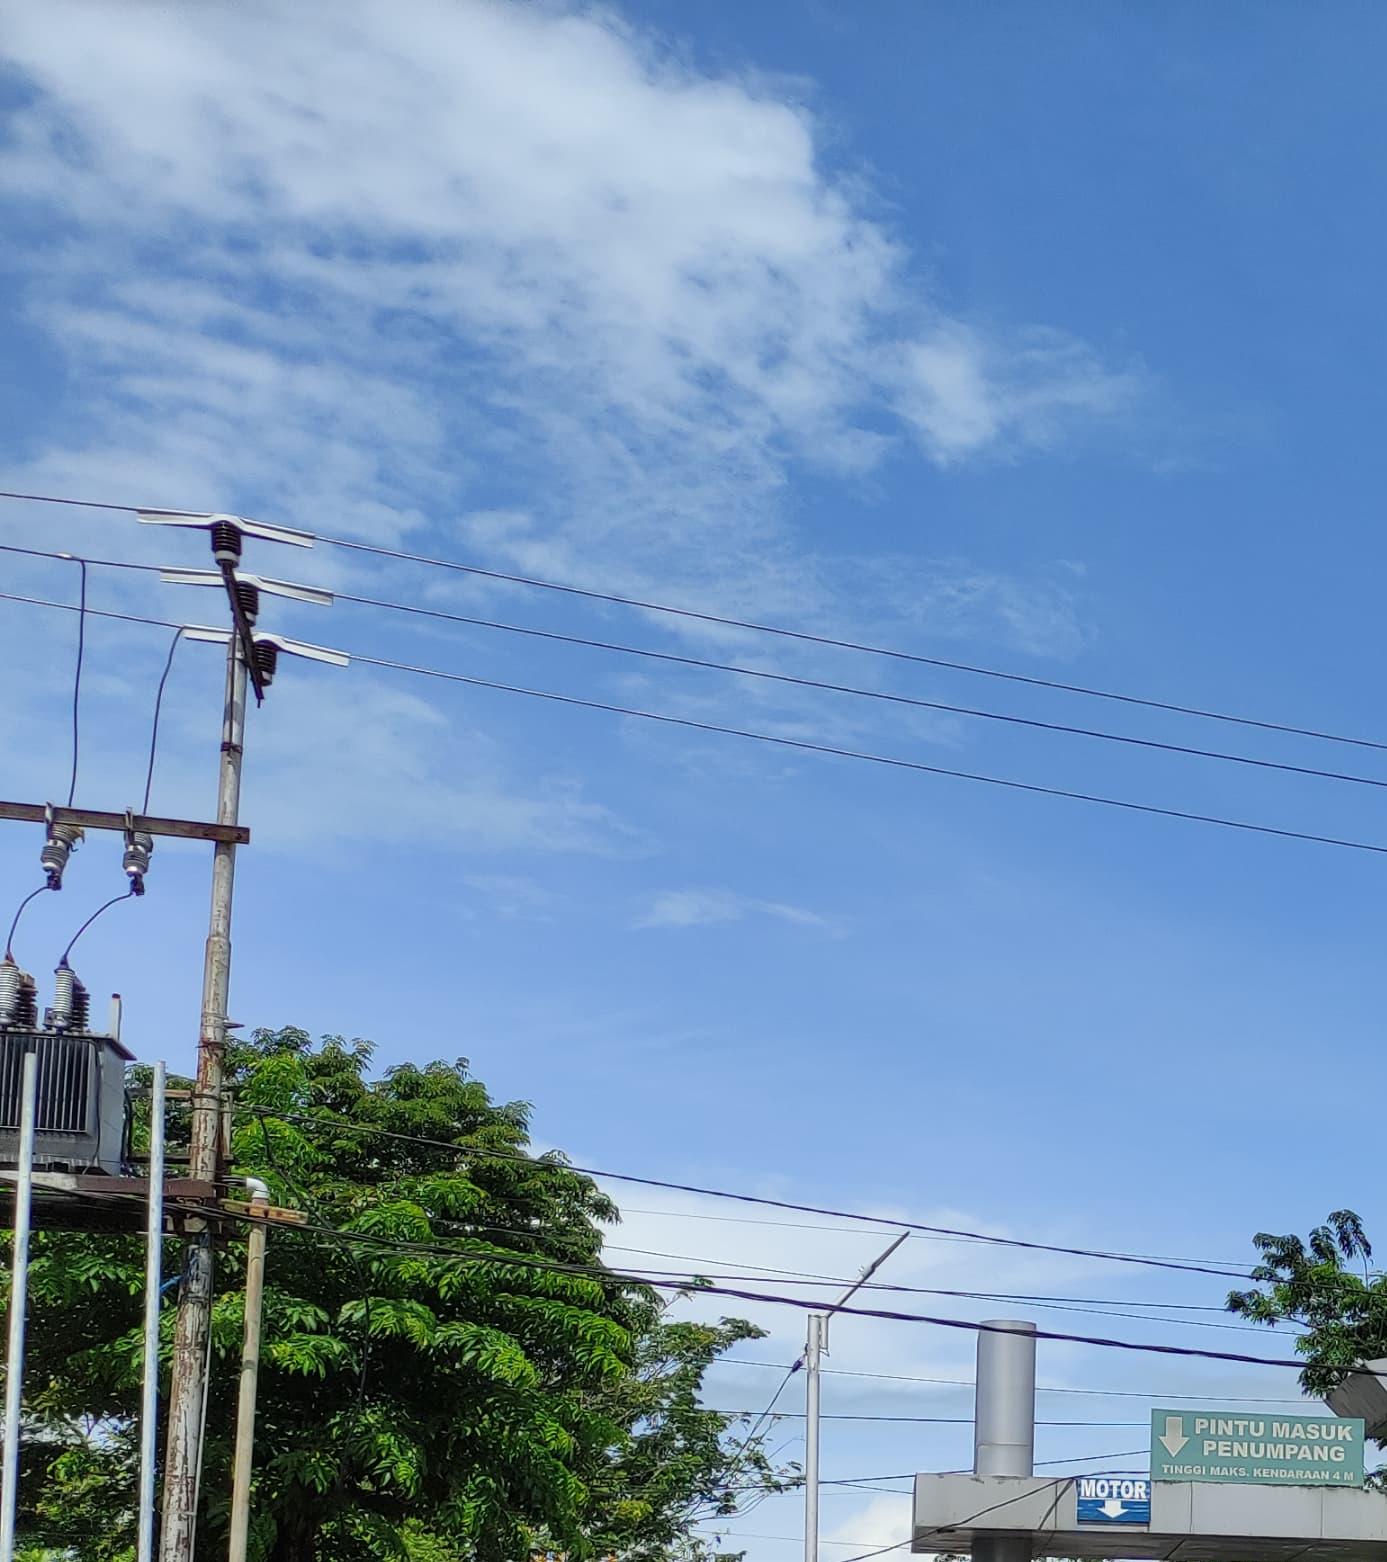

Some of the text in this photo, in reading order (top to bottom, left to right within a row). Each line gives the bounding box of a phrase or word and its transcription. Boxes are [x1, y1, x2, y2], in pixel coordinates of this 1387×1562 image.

[1194, 1417, 1353, 1442] PINTU MASUK
[1203, 1440, 1345, 1462] PENUMPANG
[1162, 1464, 1354, 1481] TINGGI MAKS. KENDARAAN 4 M
[1080, 1479, 1147, 1499] MOTOR
